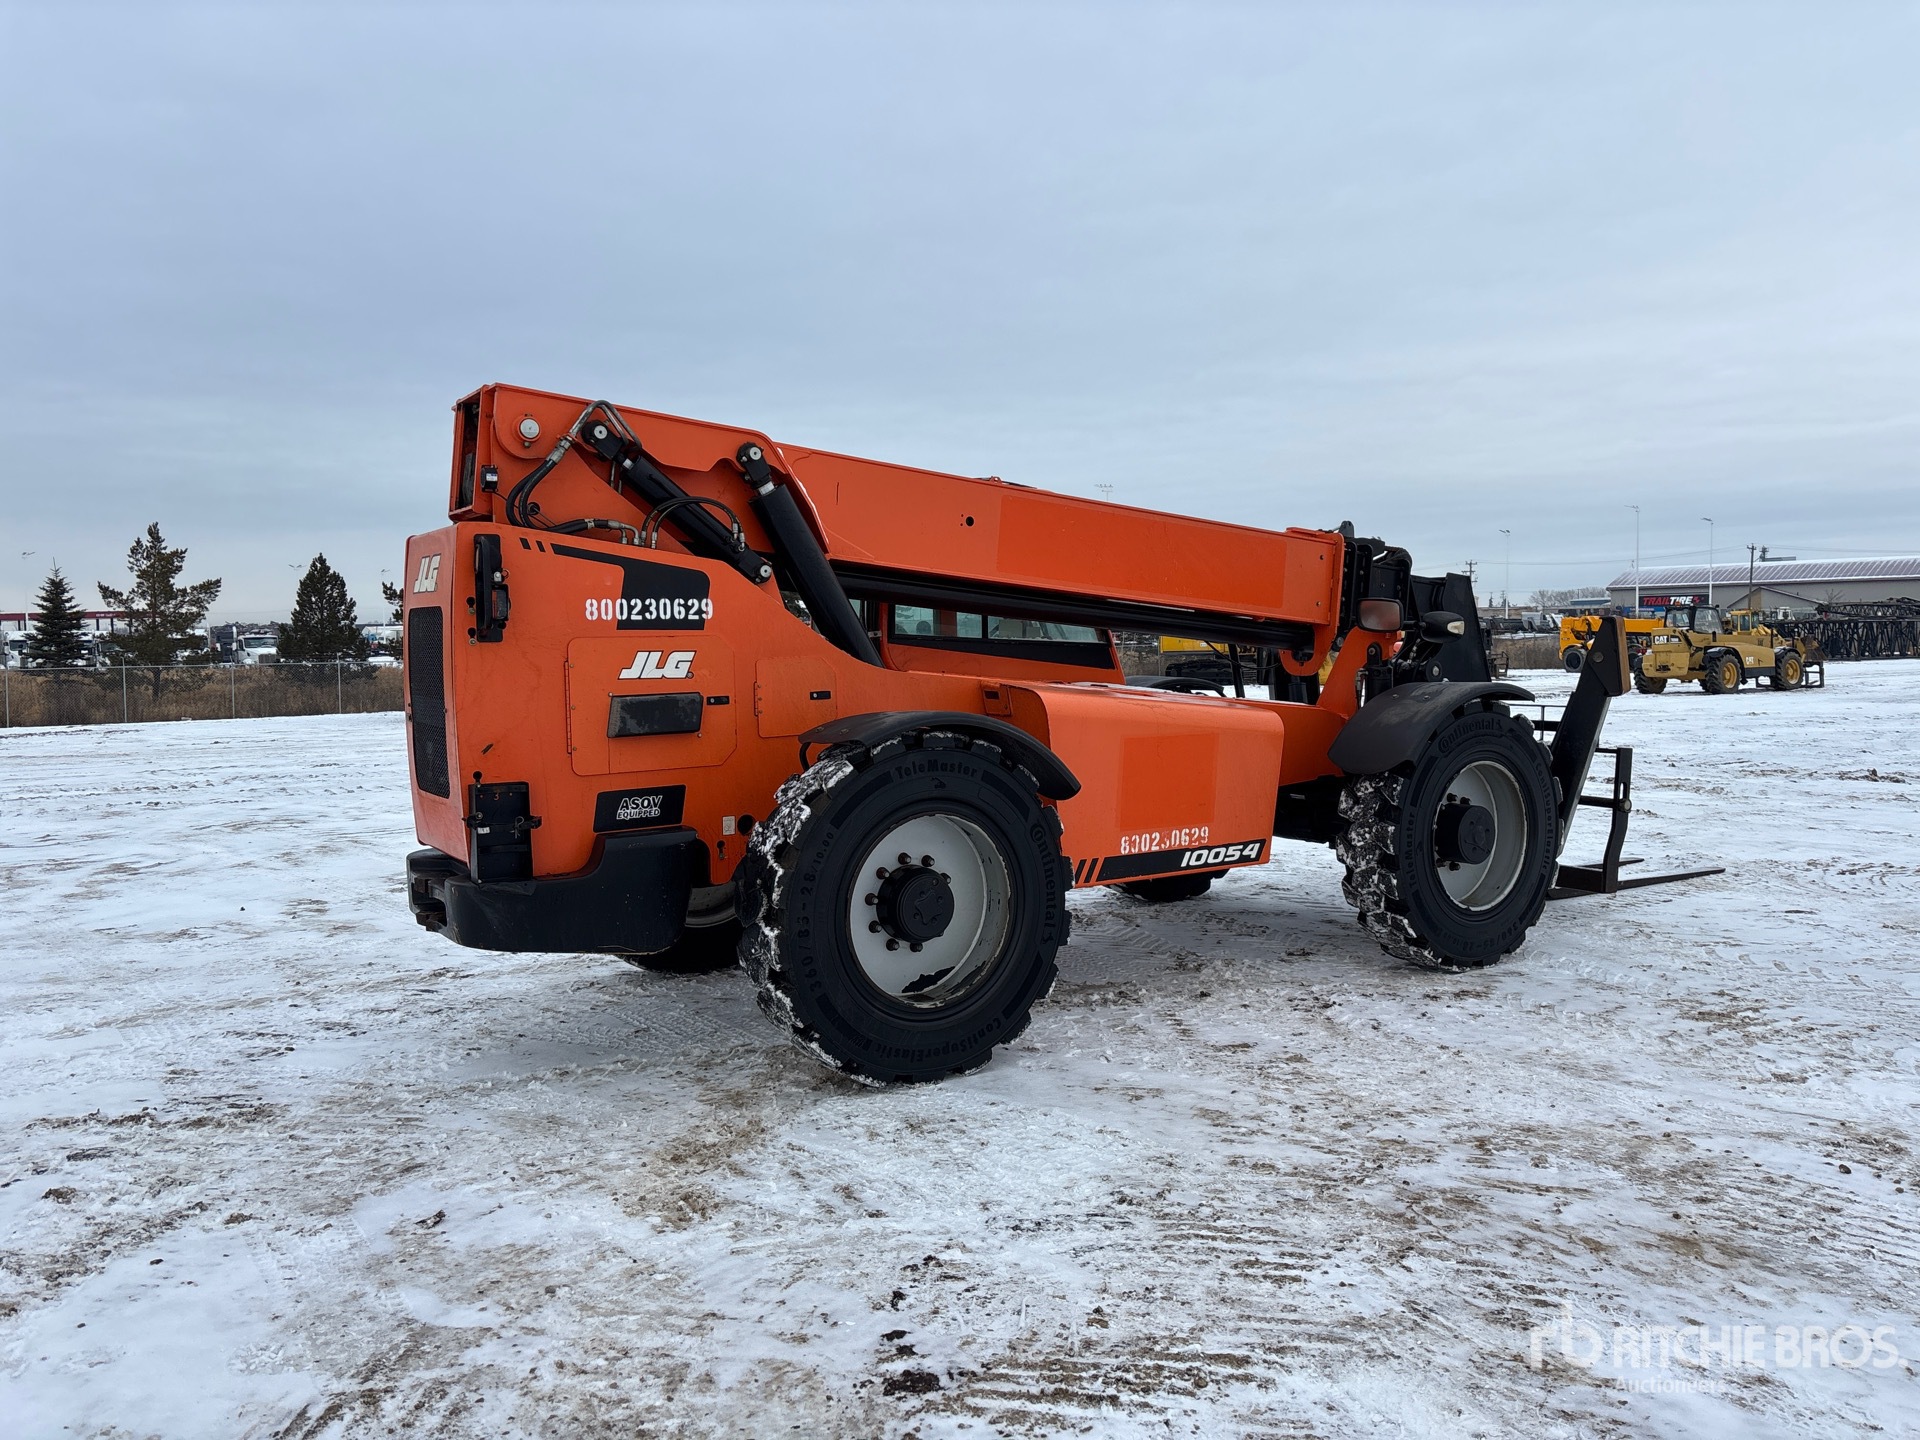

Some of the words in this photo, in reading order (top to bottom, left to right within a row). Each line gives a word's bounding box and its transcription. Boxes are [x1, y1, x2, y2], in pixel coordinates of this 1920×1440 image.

[413, 553, 441, 594] JLG
[585, 598, 714, 621] 800230629
[1654, 635, 1668, 645] CAT
[618, 650, 697, 680] JLG
[1745, 656, 1754, 665] CAT
[1438, 717, 1494, 753] Continental
[895, 759, 977, 779] TeleMaster
[616, 808, 661, 821] EQUIPPED
[619, 795, 663, 811] ASOV
[1181, 843, 1260, 868] 10054
[1405, 812, 1416, 888] TeleMaster
[1030, 819, 1057, 928] Continental
